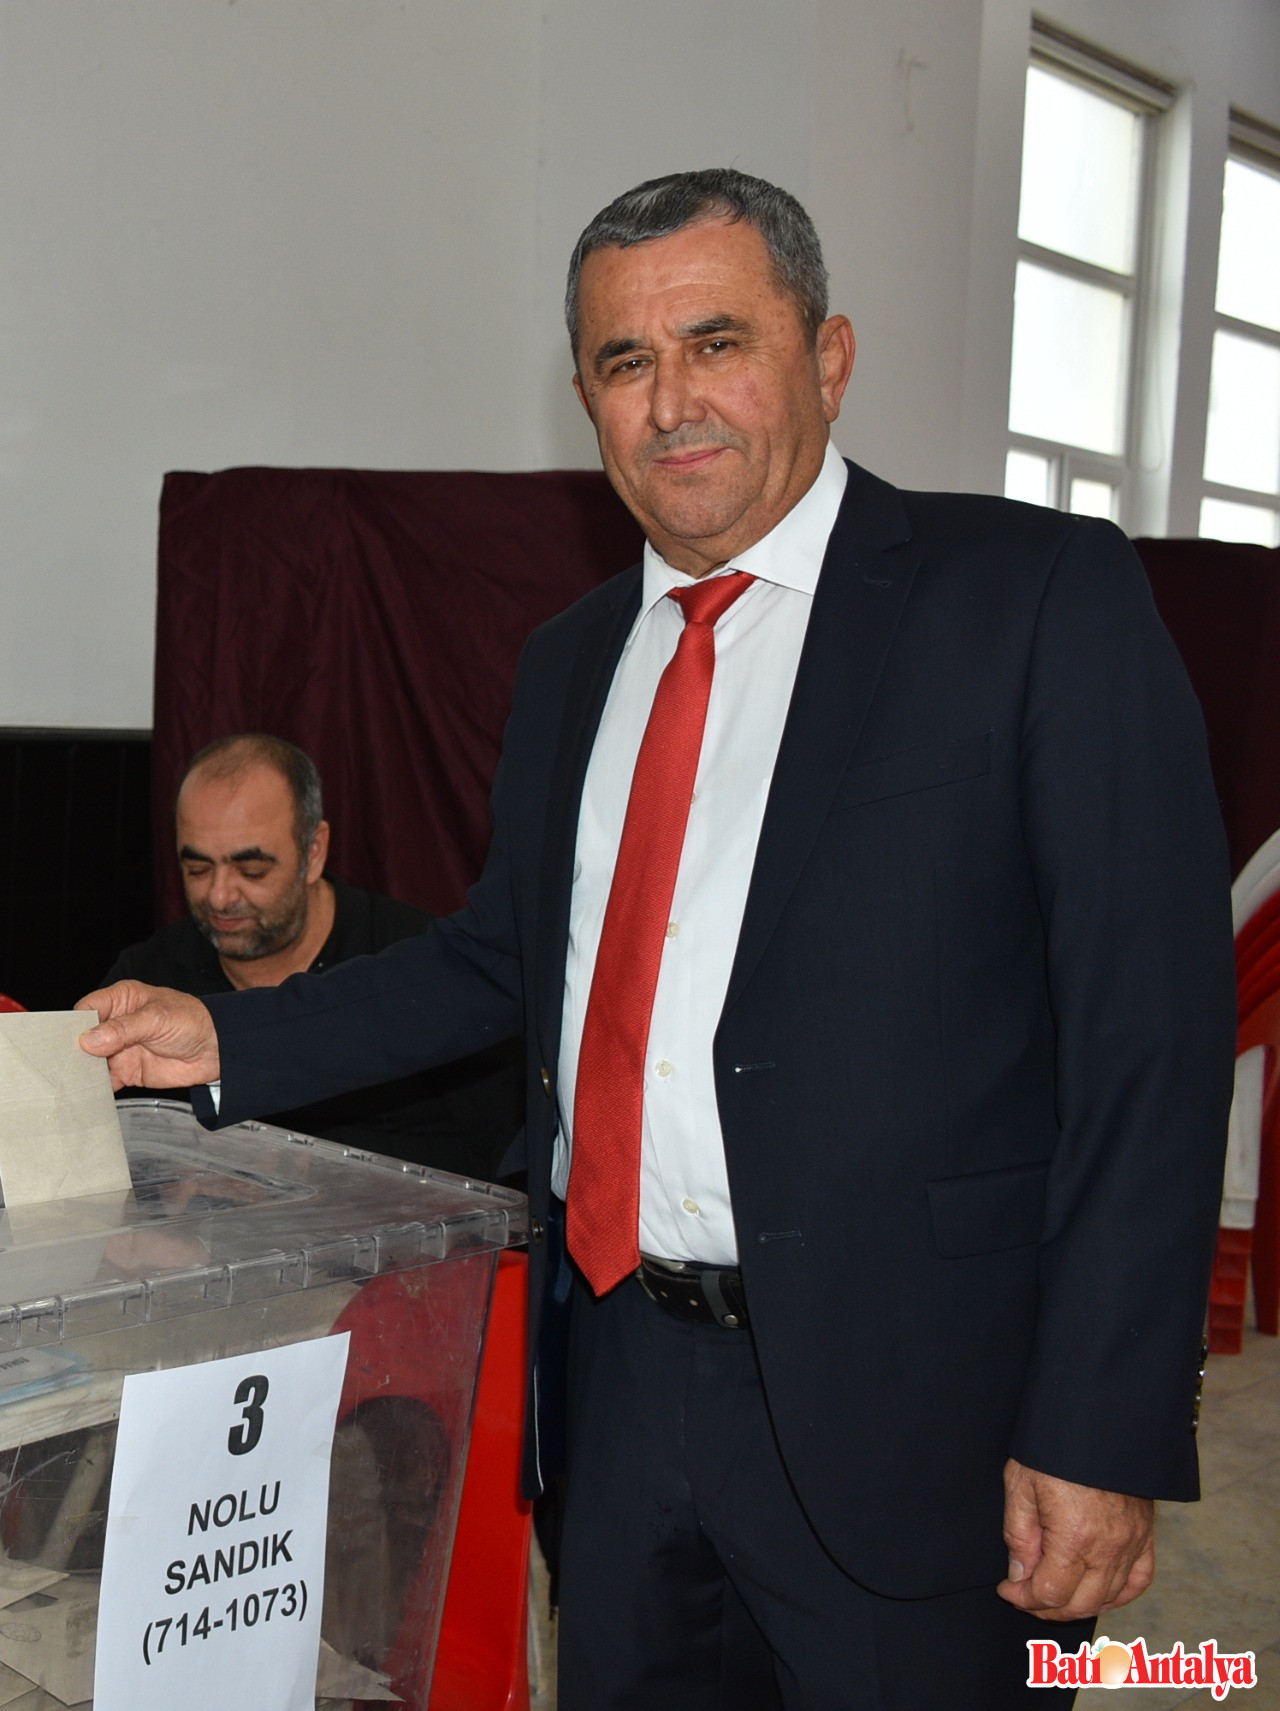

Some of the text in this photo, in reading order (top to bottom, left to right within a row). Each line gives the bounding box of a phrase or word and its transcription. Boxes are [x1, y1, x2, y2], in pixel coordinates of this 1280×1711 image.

[227, 1374, 269, 1456] 3
[187, 1480, 281, 1536] NOLU
[164, 1529, 294, 1595] SANDIK
[142, 1580, 308, 1665] (714-1073)
